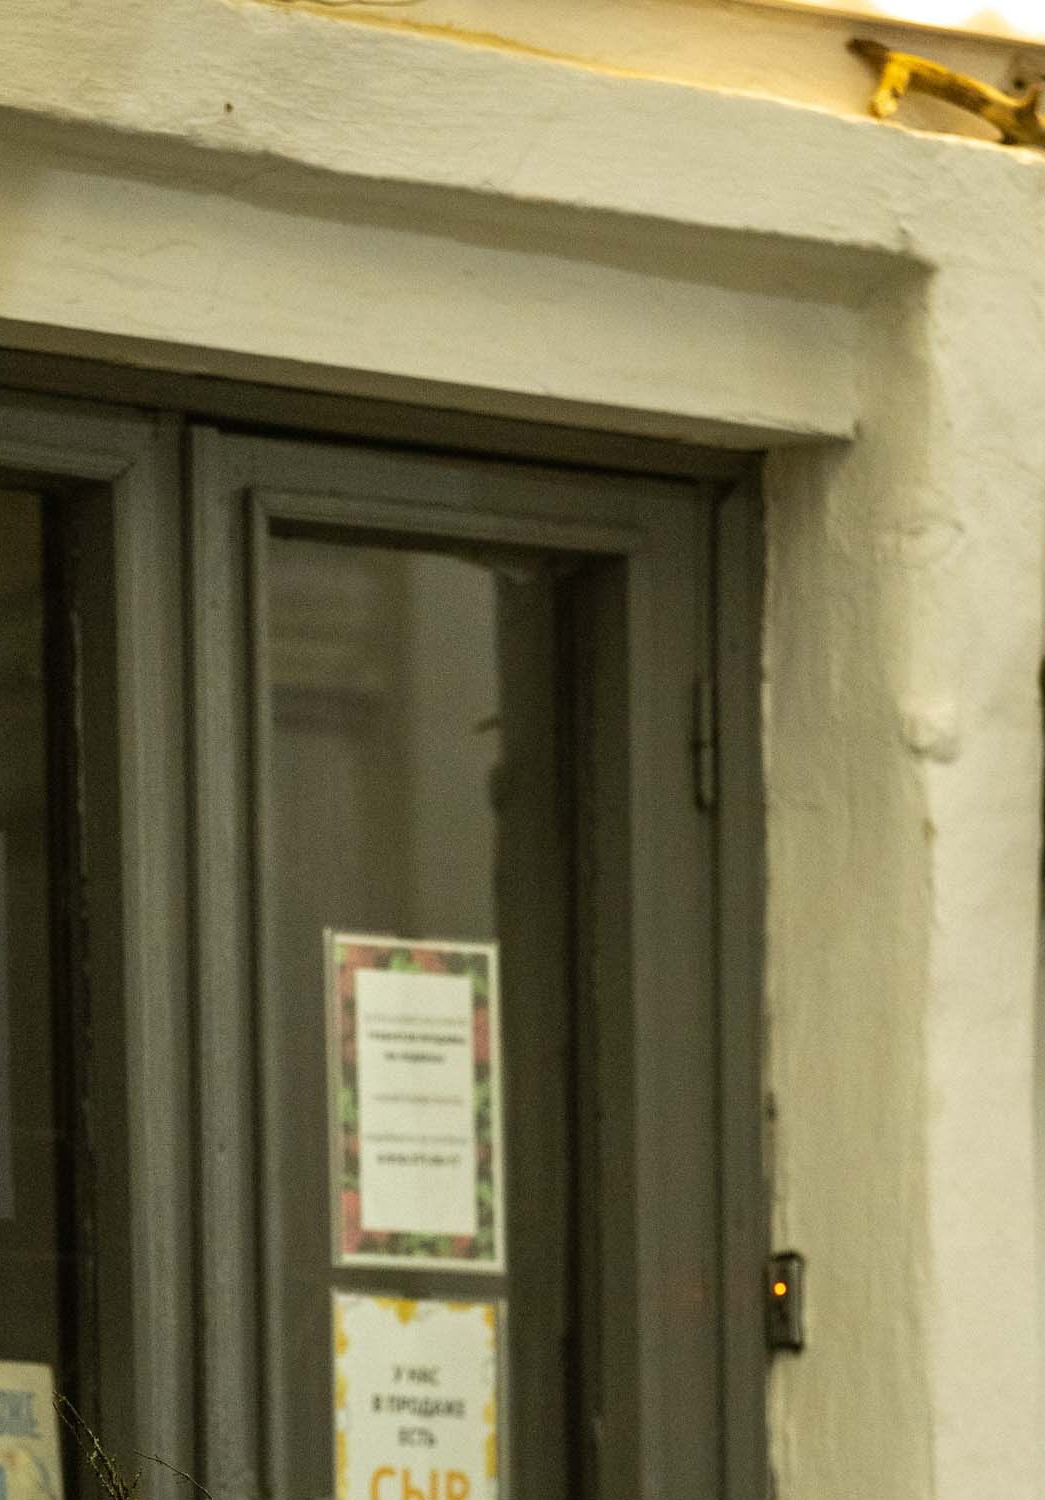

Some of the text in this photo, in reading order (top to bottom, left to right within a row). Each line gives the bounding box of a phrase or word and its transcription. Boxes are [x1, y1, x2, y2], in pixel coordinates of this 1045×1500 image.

[407, 1365, 440, 1388] НАС
[386, 1394, 466, 1420] ПРОДАЖЕ
[396, 1426, 437, 1449] ЕСТЬ
